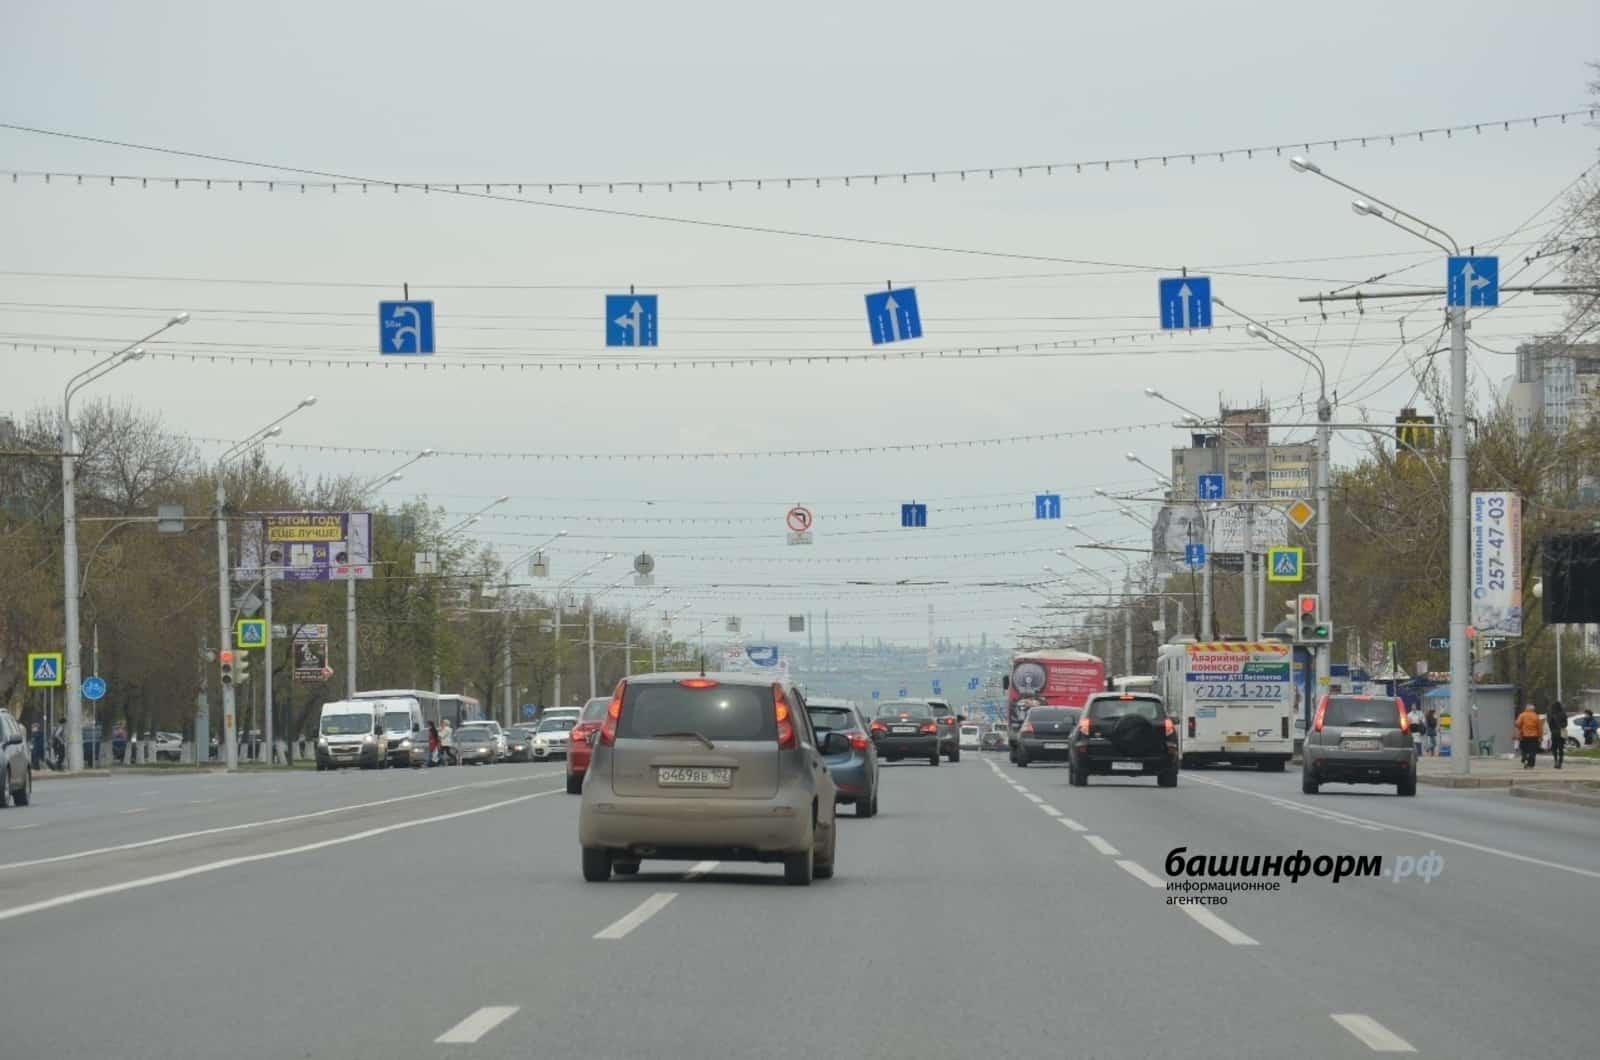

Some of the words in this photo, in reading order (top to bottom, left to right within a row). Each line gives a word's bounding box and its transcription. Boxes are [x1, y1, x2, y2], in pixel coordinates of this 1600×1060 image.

[1475, 497, 1485, 522] мир
[312, 515, 341, 527] ГОДУ
[297, 528, 340, 538] ЛУЧШЕ!
[1488, 497, 1505, 591] 257-47-03
[1192, 653, 1250, 664] Аварийный
[1192, 663, 1239, 672] комиссар
[1207, 683, 1281, 698] 222-1-222
